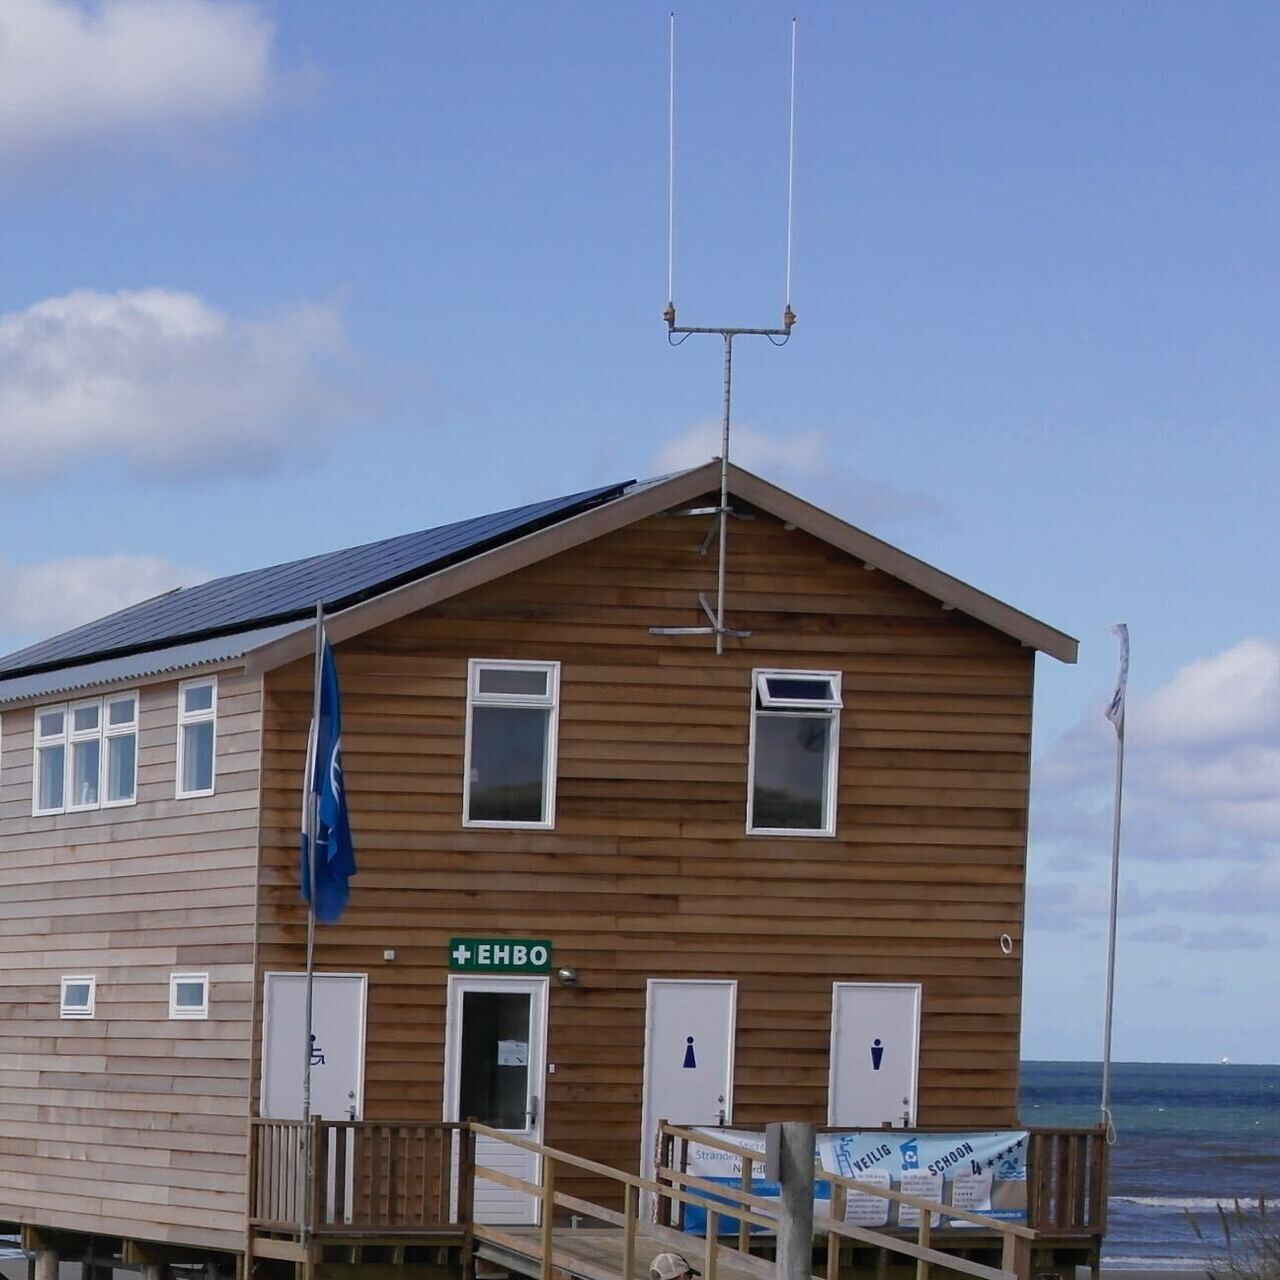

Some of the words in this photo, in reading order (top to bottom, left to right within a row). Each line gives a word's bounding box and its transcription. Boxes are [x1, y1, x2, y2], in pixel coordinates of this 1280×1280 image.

[478, 945, 548, 966] EHBO
[853, 1143, 892, 1172] VEILIG
[928, 1142, 974, 1177] SCHOON
[971, 1159, 982, 1175] 4
